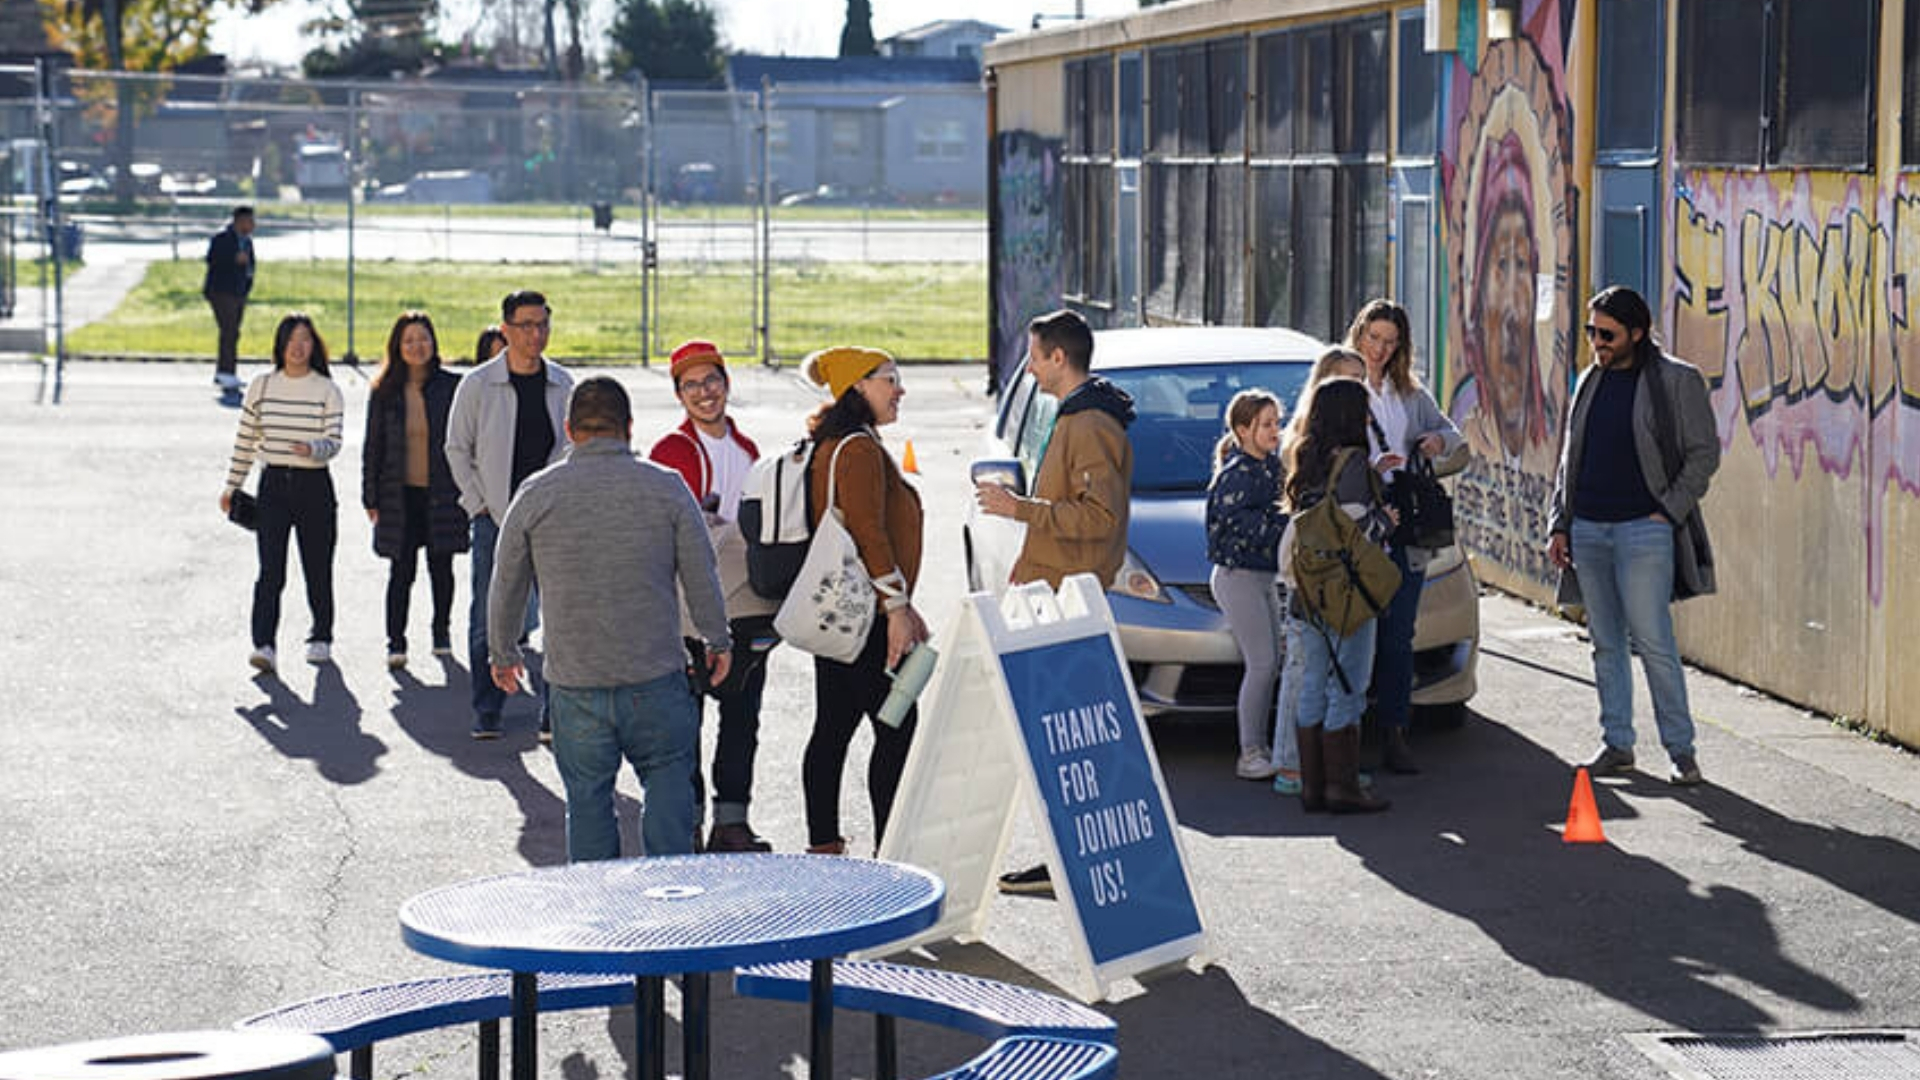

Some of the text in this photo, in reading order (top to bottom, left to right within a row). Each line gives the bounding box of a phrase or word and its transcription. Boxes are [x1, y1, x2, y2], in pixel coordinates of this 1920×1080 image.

[1041, 700, 1122, 755] THANKS
[1058, 760, 1099, 803] FOR
[1076, 800, 1153, 856] JOINING
[1089, 859, 1127, 906] US!
